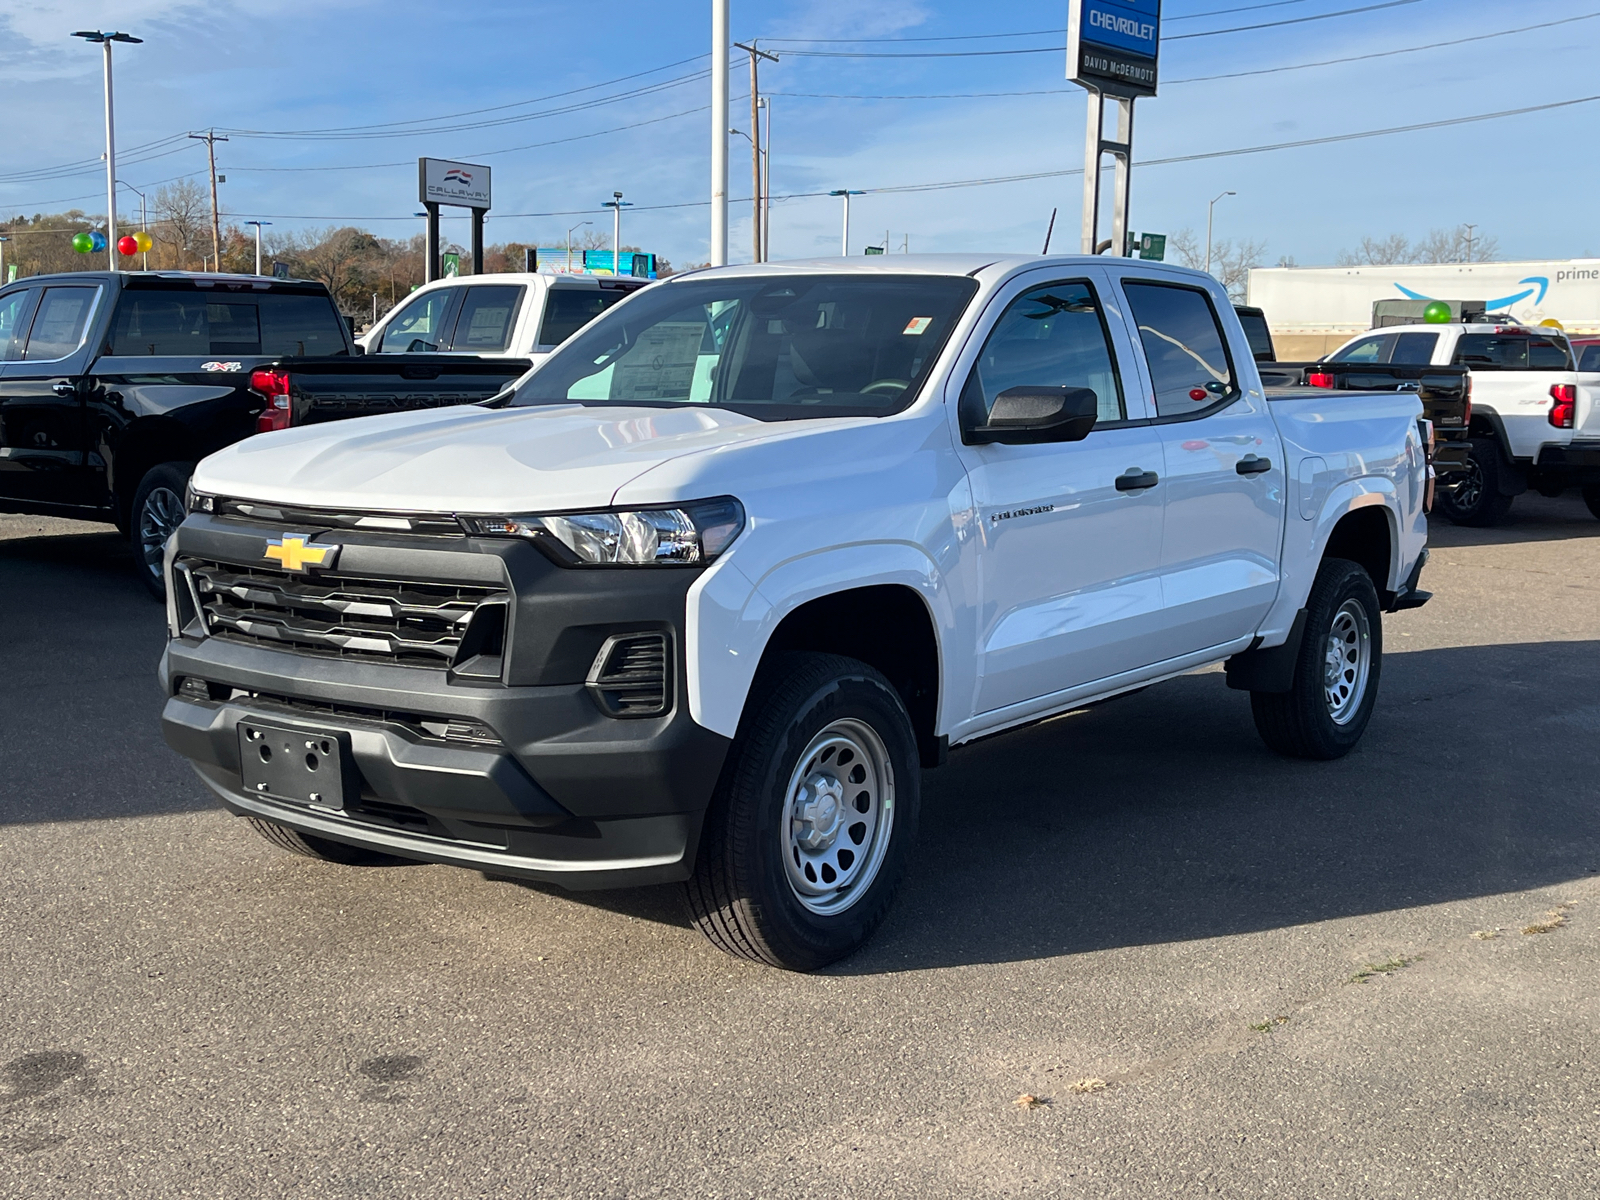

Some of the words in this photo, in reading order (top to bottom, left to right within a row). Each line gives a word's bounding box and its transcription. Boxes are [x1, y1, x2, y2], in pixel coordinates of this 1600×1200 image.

[1090, 10, 1155, 40] CHEVROLET
[1084, 55, 1108, 71] DAVID
[1110, 61, 1154, 82] McDERMOTT
[428, 186, 488, 198] CALLAWAY
[1556, 266, 1599, 283] prime
